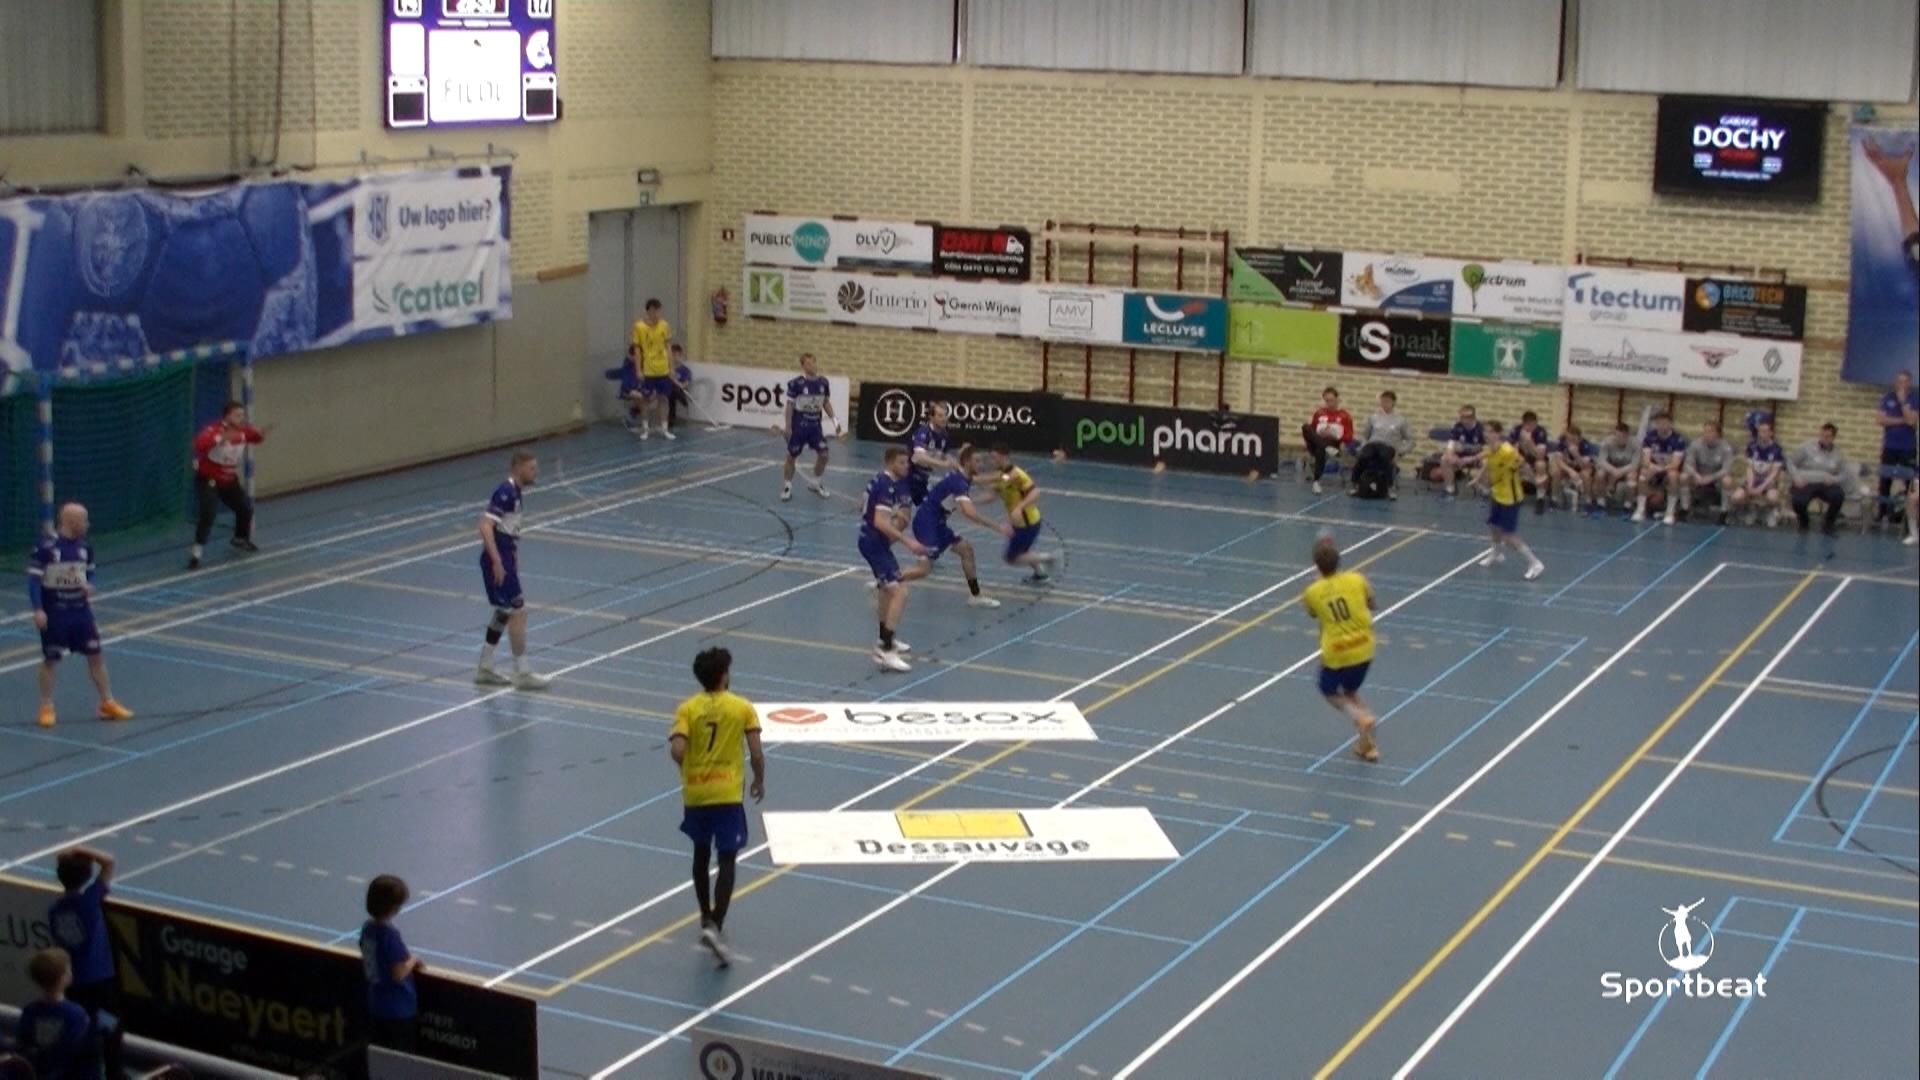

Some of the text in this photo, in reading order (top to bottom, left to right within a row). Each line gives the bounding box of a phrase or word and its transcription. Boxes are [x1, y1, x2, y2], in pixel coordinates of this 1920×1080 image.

[1693, 125, 1786, 151] DOCHY
[399, 198, 492, 230] Uw logo hier?
[750, 232, 791, 248] PUBLIC
[759, 275, 782, 303] K
[1590, 284, 1682, 312] tectum
[1055, 303, 1088, 318] AMV
[1143, 322, 1207, 338] LECLUYSE
[721, 382, 785, 412] spot
[884, 400, 906, 423] H
[1076, 415, 1263, 457] poul pharm
[1328, 597, 1350, 622] 10
[705, 721, 718, 753] 7
[855, 839, 1091, 857] Dessauvage
[161, 924, 249, 975] Garage
[163, 960, 345, 1046] Naeyaert
